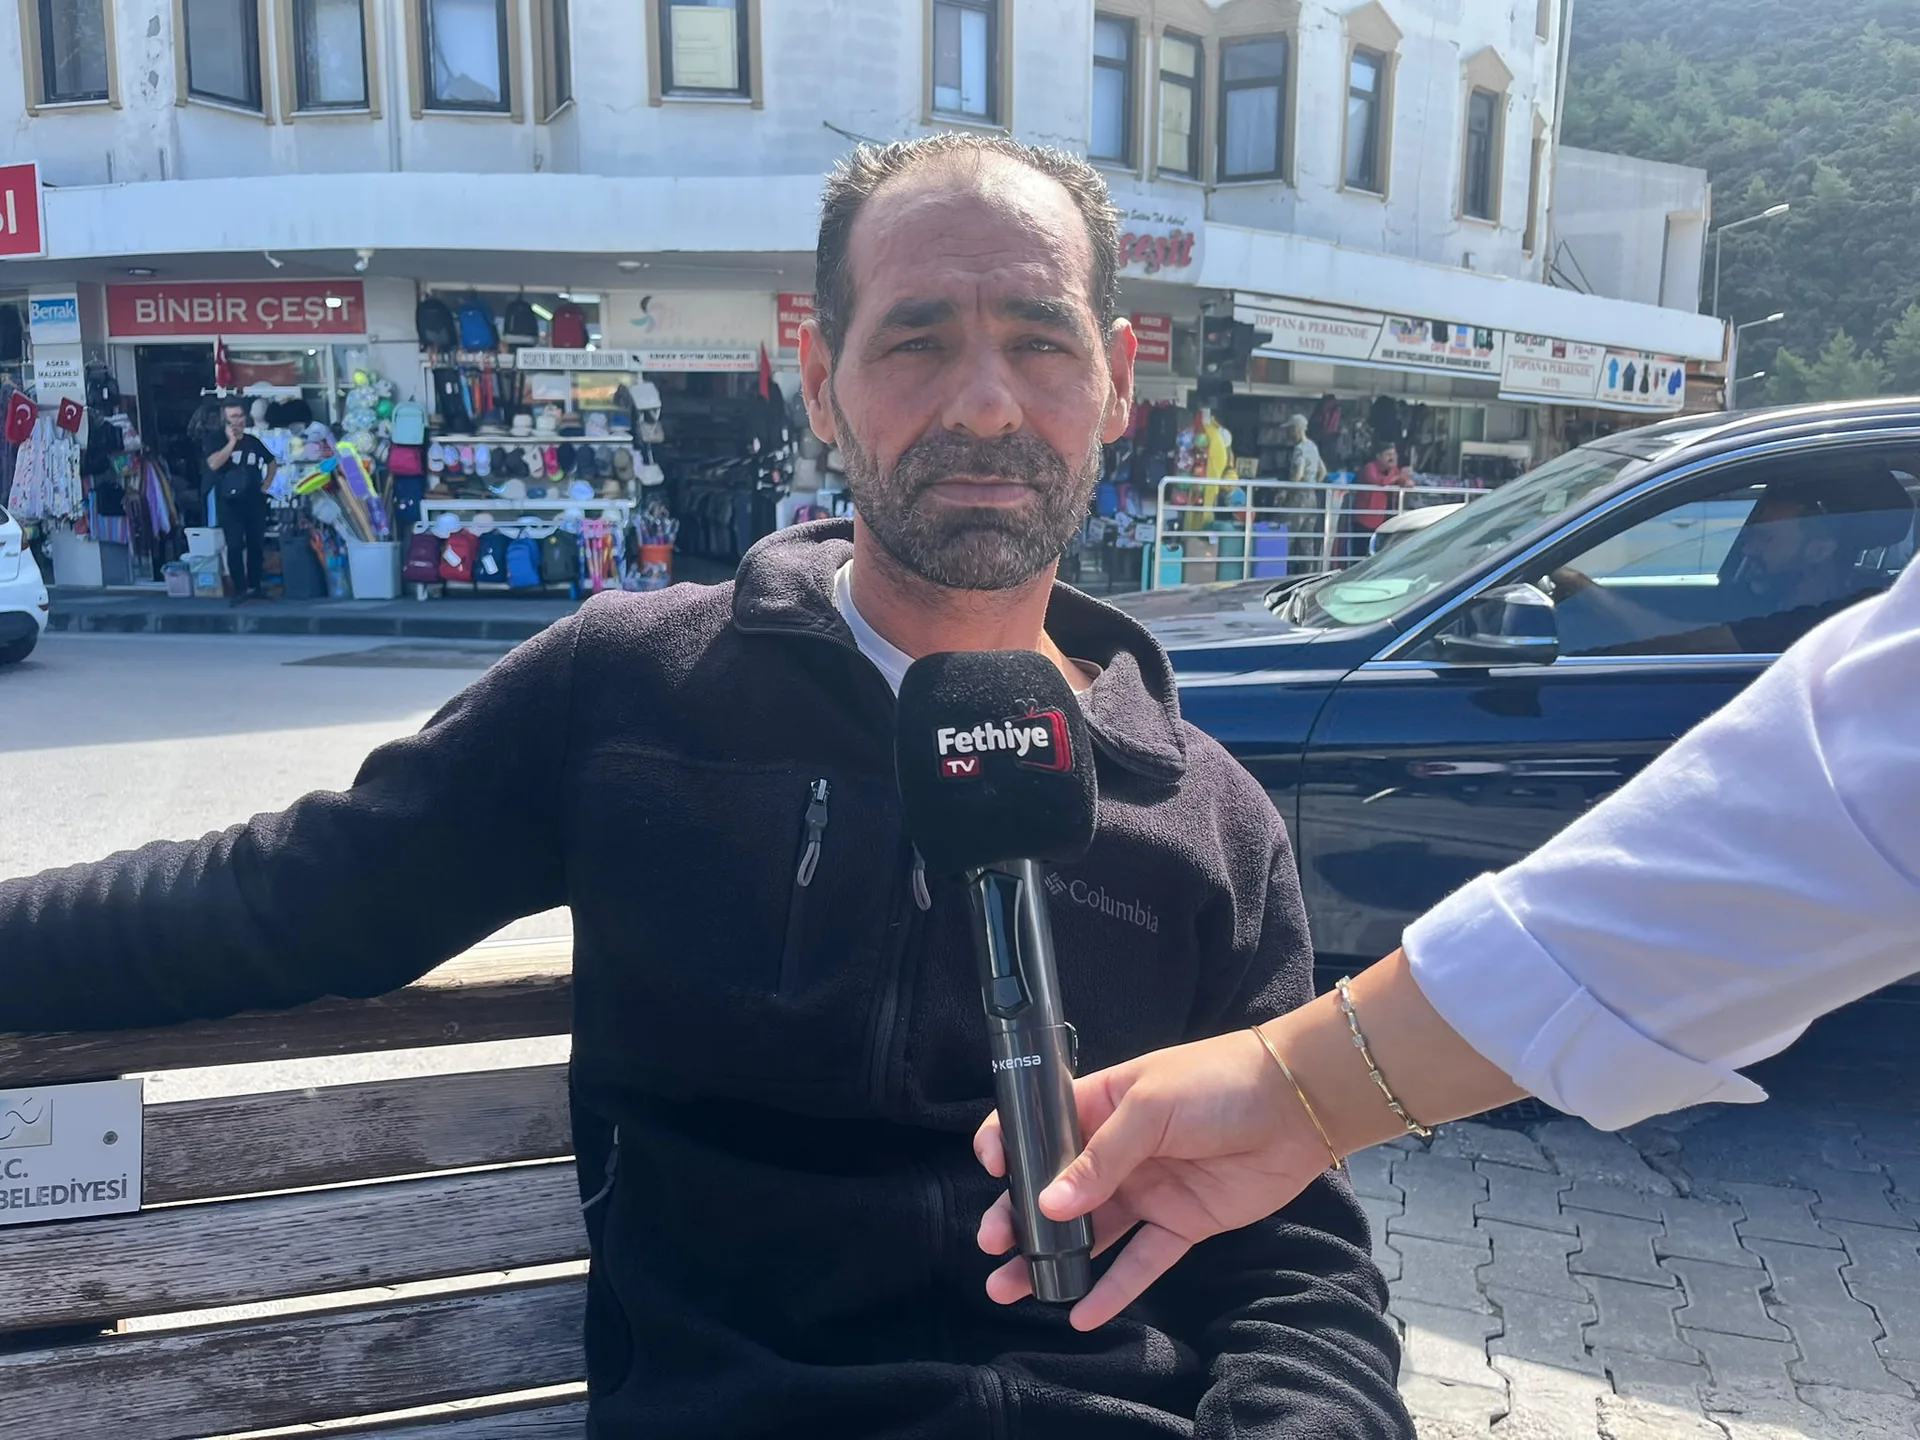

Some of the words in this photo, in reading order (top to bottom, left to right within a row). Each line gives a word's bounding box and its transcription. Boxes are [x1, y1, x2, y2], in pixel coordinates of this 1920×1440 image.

[31, 301, 75, 320] Berrak
[135, 293, 247, 323] BİNBİR
[256, 291, 354, 329] ÇEŞİT
[1254, 314, 1296, 330] TOPTAN
[1299, 322, 1306, 331] &
[1309, 320, 1368, 339] PERAKENDE
[937, 721, 1049, 757] Fethiye
[947, 759, 975, 774] TV
[1069, 879, 1158, 934] Columbia
